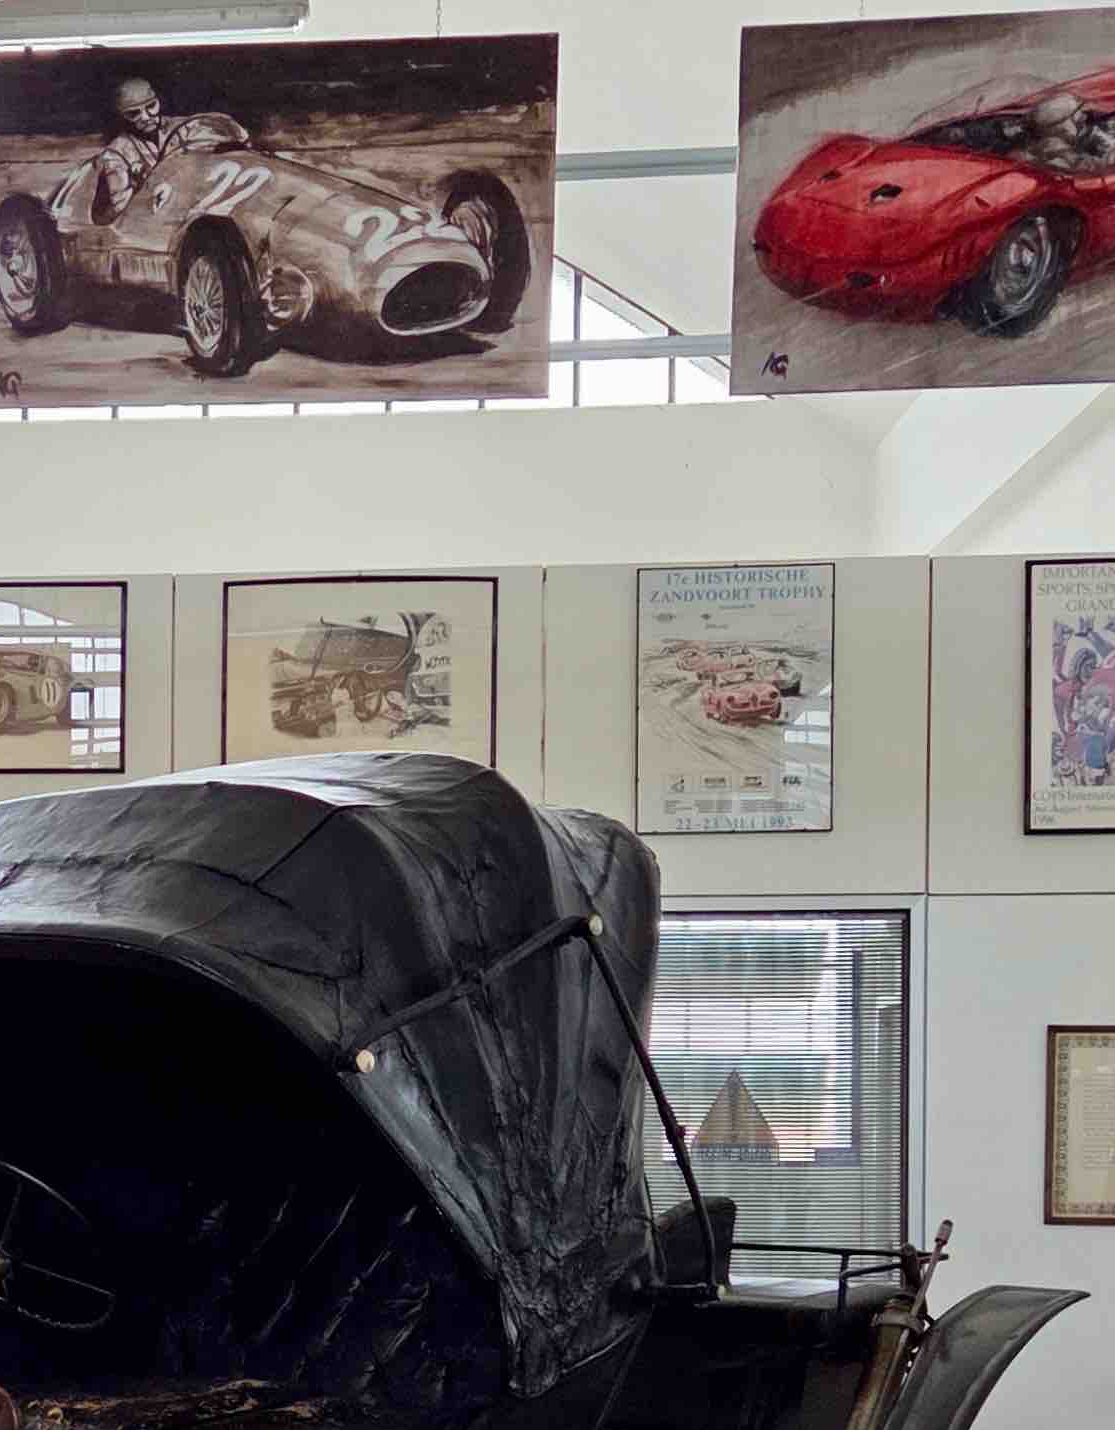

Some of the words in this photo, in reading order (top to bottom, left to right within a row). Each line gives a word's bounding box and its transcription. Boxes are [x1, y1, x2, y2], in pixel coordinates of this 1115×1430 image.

[187, 160, 272, 216] 22
[694, 569, 811, 585] HISTORISCHE
[649, 588, 751, 604] ZANDVOORT
[758, 586, 826, 600] TROPHY
